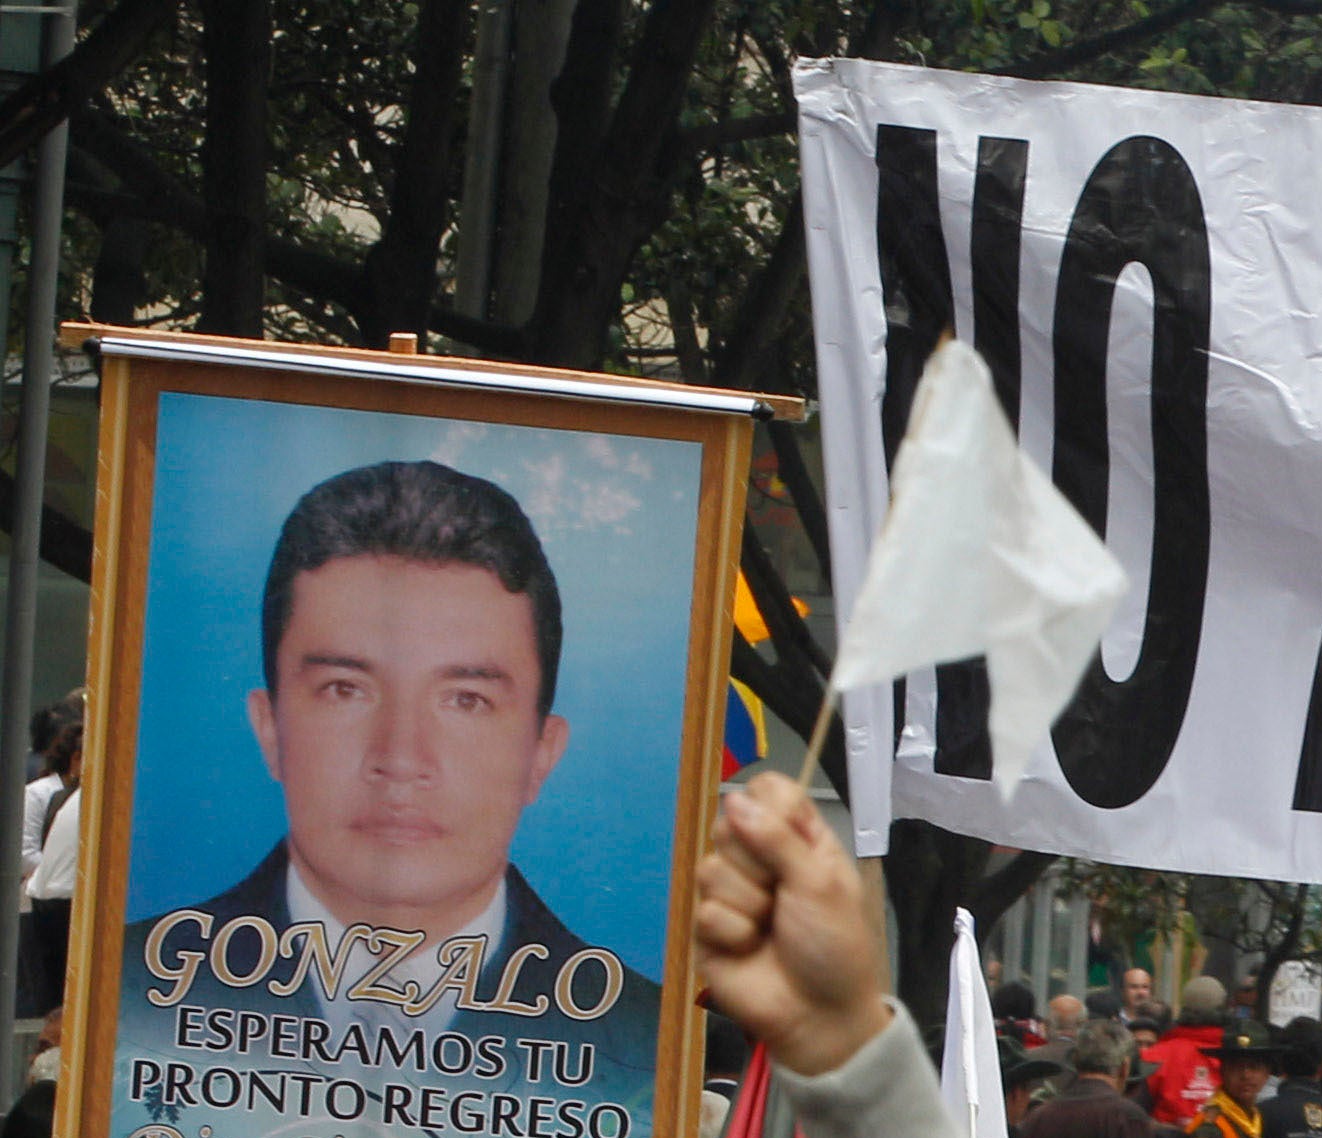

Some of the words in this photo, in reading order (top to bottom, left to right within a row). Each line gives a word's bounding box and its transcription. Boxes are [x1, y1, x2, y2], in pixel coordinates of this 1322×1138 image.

[877, 125, 1212, 810] NO
[143, 908, 626, 1022] GONZALO
[130, 1058, 367, 1122] PRONTO
[176, 1006, 505, 1080] ESPERAMOS
[515, 1038, 595, 1087] TU
